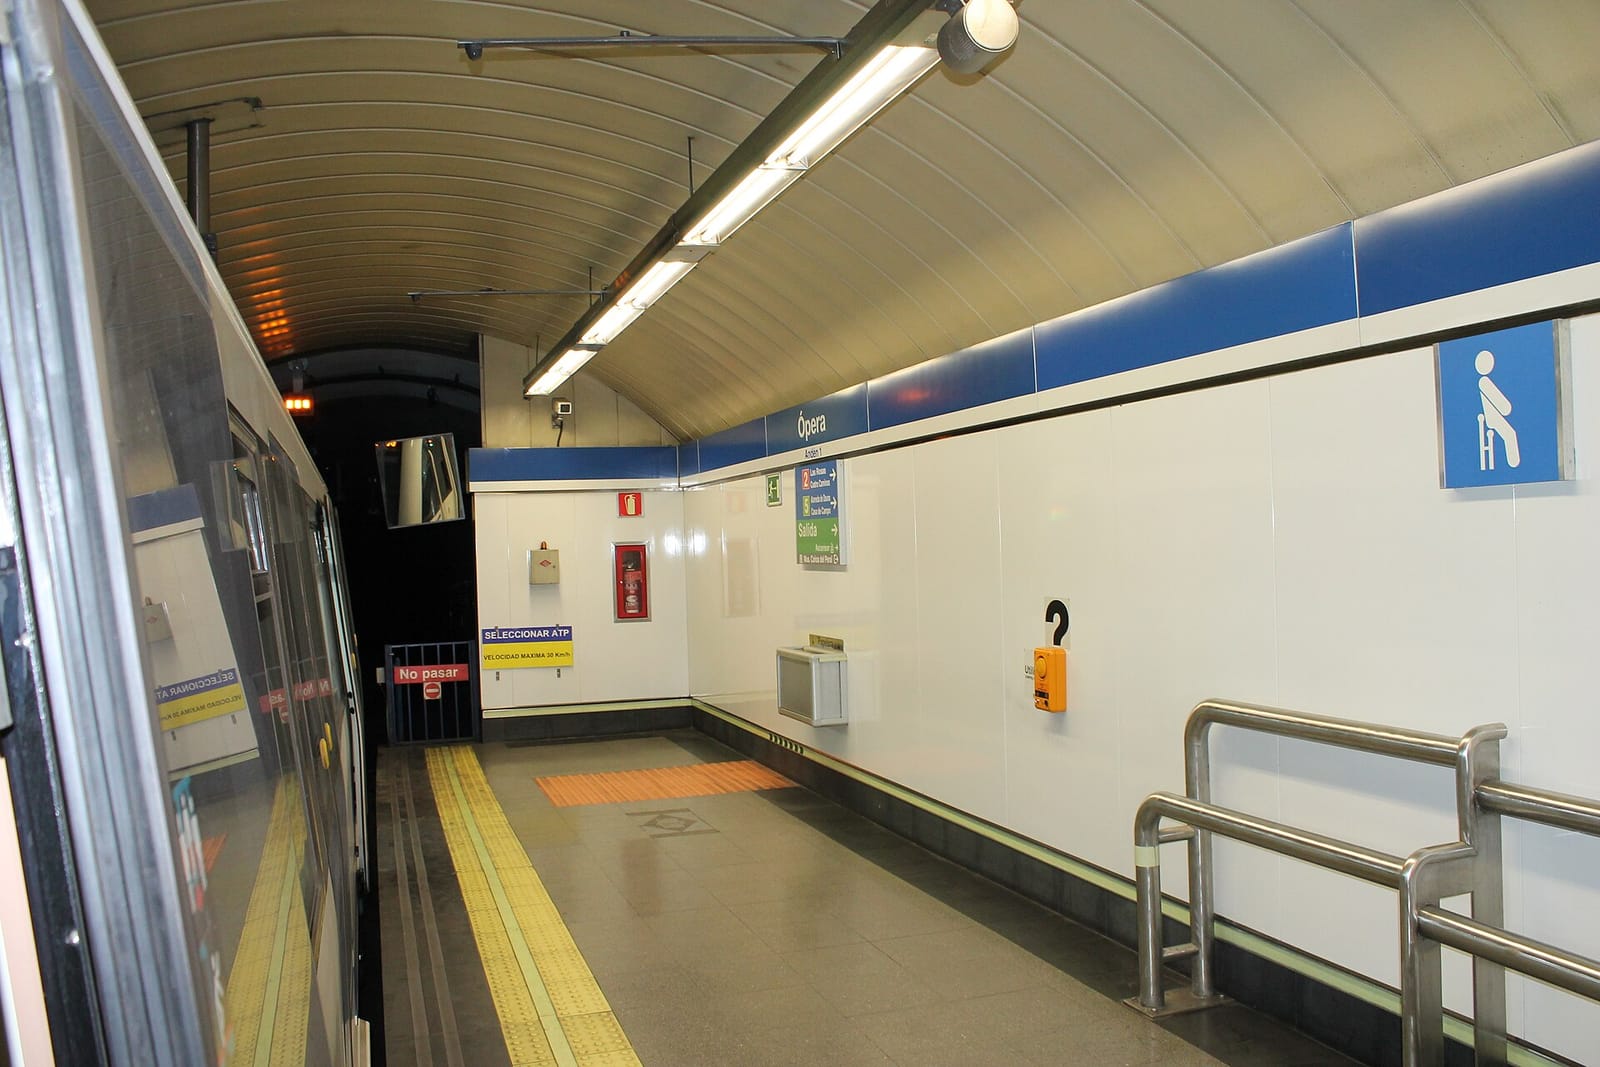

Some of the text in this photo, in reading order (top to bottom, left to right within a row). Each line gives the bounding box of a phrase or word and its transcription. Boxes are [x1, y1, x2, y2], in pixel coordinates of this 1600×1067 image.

[797, 410, 826, 442] Ópera
[803, 471, 809, 487] 2
[804, 497, 809, 514] 5
[798, 522, 817, 537] Salida
[484, 629, 570, 640] SELECCIONAR ATP
[399, 668, 459, 682] No pasar
